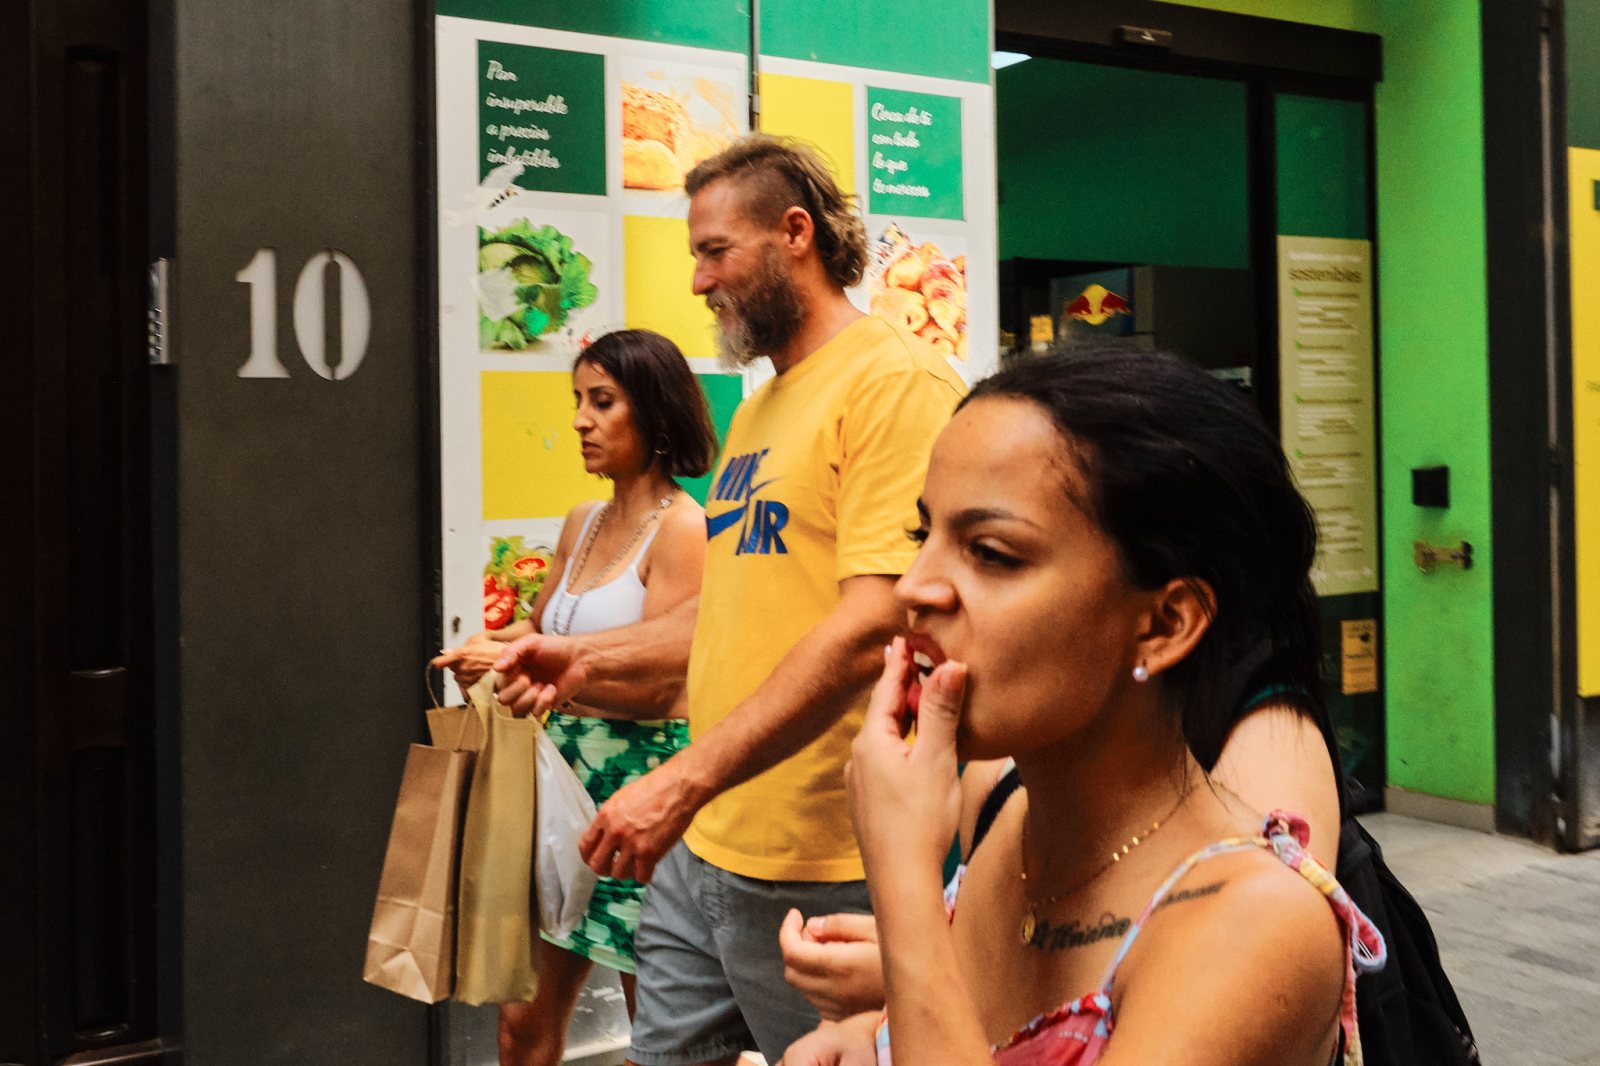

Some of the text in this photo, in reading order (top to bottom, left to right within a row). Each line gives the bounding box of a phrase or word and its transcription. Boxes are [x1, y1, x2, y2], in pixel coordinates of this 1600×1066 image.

[486, 60, 518, 81] Pan
[486, 124, 550, 142] a precios
[235, 247, 371, 381] 10
[714, 448, 769, 501] NIK
